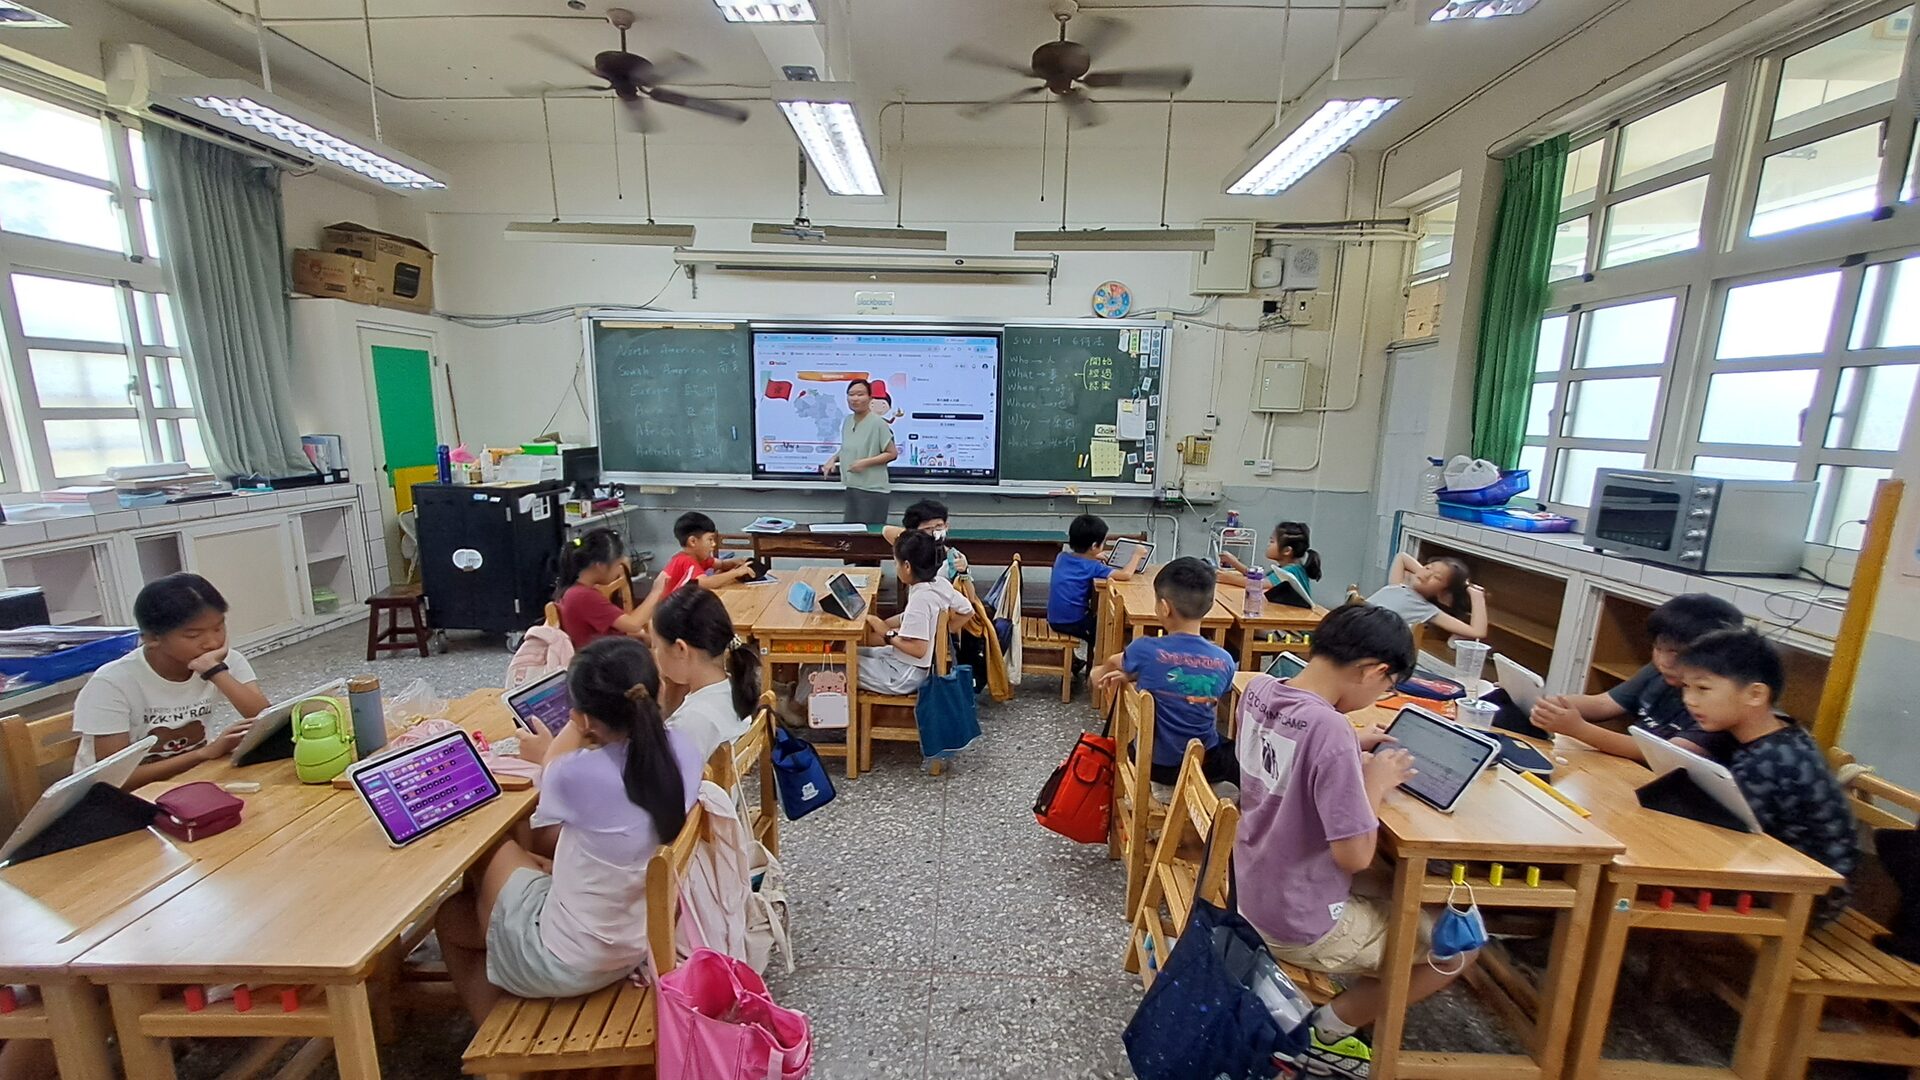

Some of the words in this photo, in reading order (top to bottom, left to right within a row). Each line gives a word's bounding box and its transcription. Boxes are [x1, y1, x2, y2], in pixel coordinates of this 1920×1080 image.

[857, 297, 892, 305] blackboard
[1009, 355, 1029, 364] Who
[1007, 368, 1033, 379] What
[1007, 382, 1035, 391] When
[1007, 397, 1037, 408] Where
[1008, 414, 1031, 431] Why
